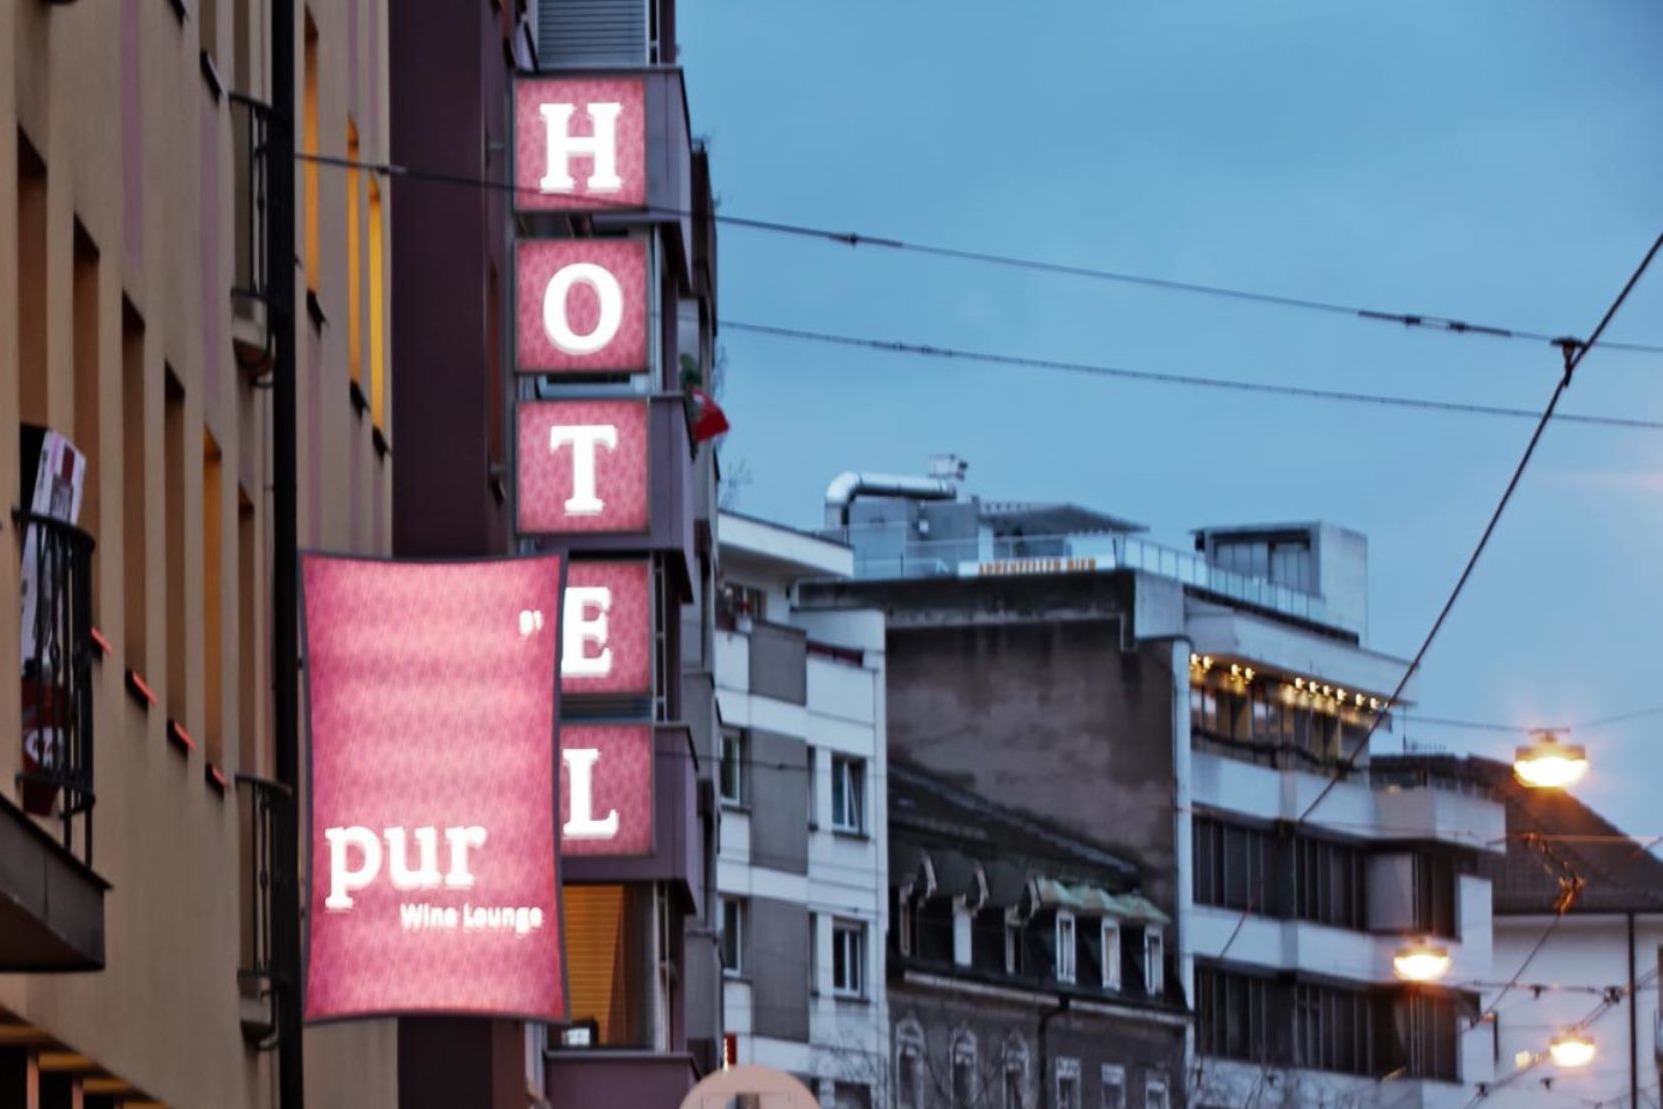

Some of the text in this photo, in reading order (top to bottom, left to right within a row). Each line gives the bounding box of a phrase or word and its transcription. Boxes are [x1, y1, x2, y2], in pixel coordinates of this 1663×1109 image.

[539, 101, 625, 841] HOTEL
[324, 823, 488, 909] pur
[399, 902, 543, 935] Wine Lounge
